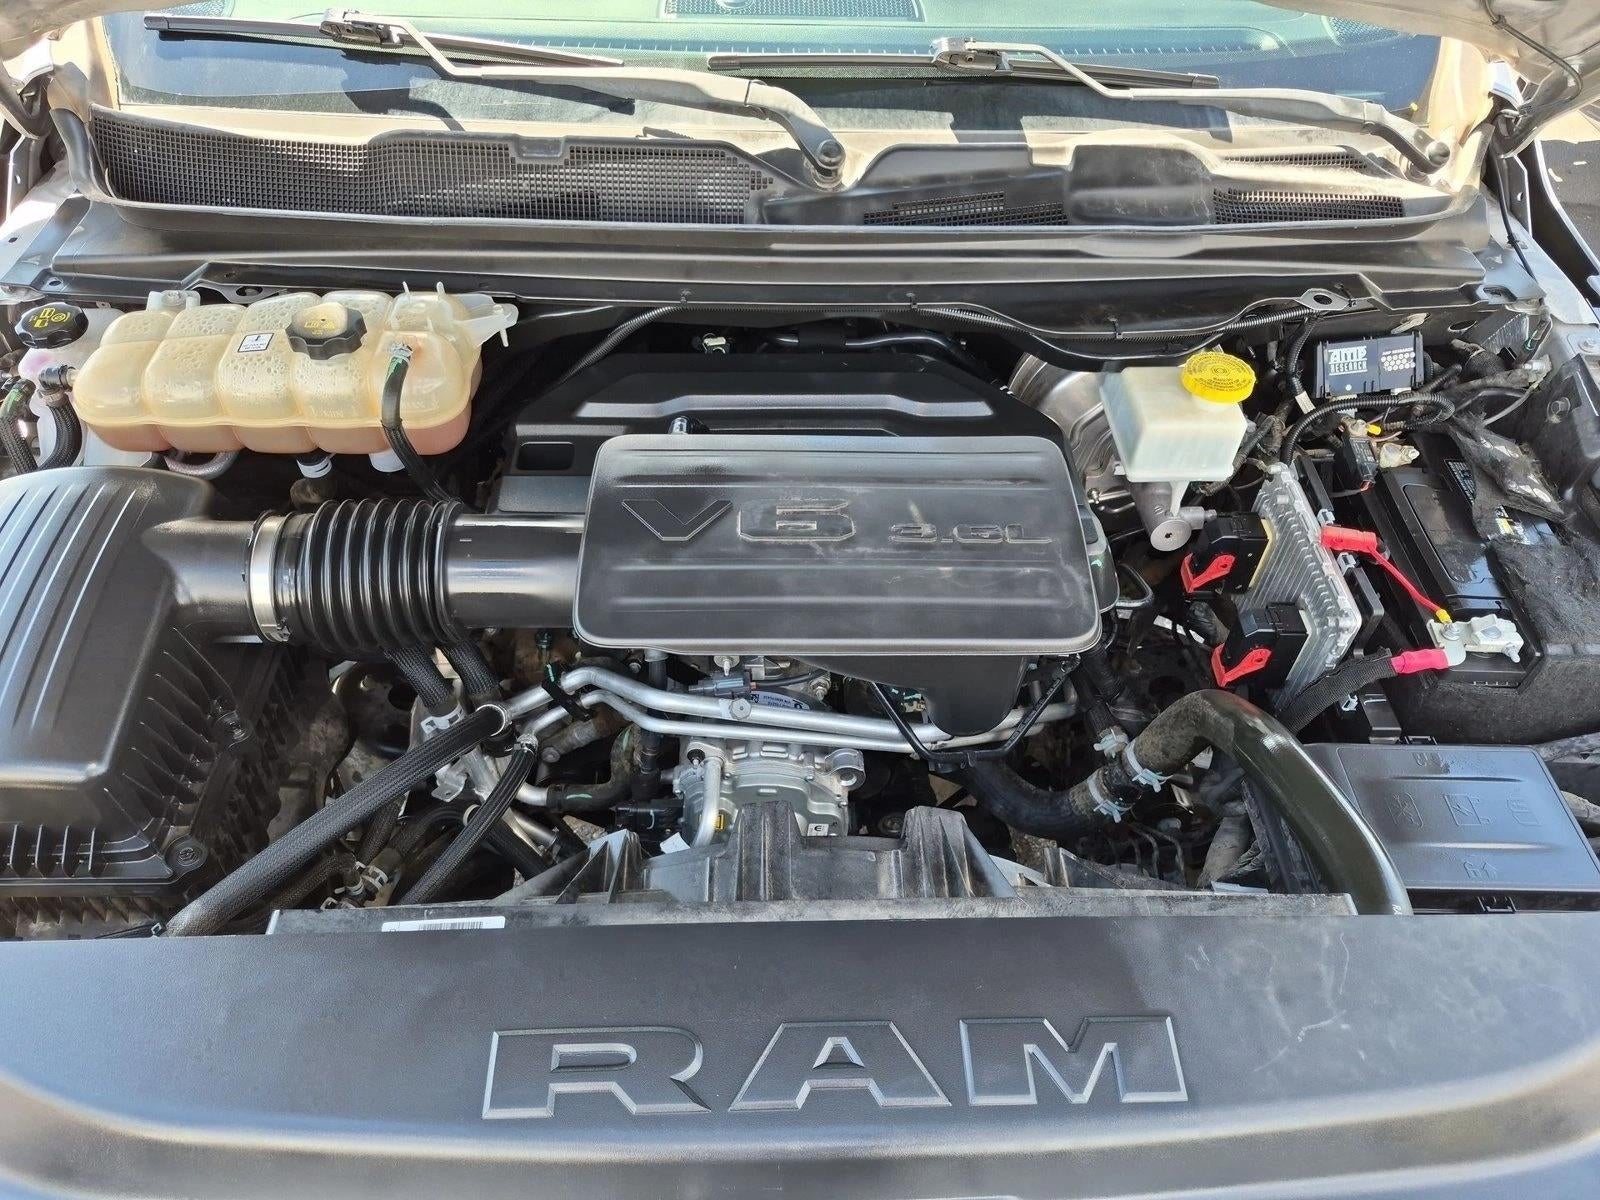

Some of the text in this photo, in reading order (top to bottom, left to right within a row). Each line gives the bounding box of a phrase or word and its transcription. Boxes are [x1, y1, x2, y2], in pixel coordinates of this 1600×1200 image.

[1330, 361, 1367, 373] RESEARCH
[888, 523, 1053, 544] 3.6L
[481, 1015, 1189, 1120] RAM
